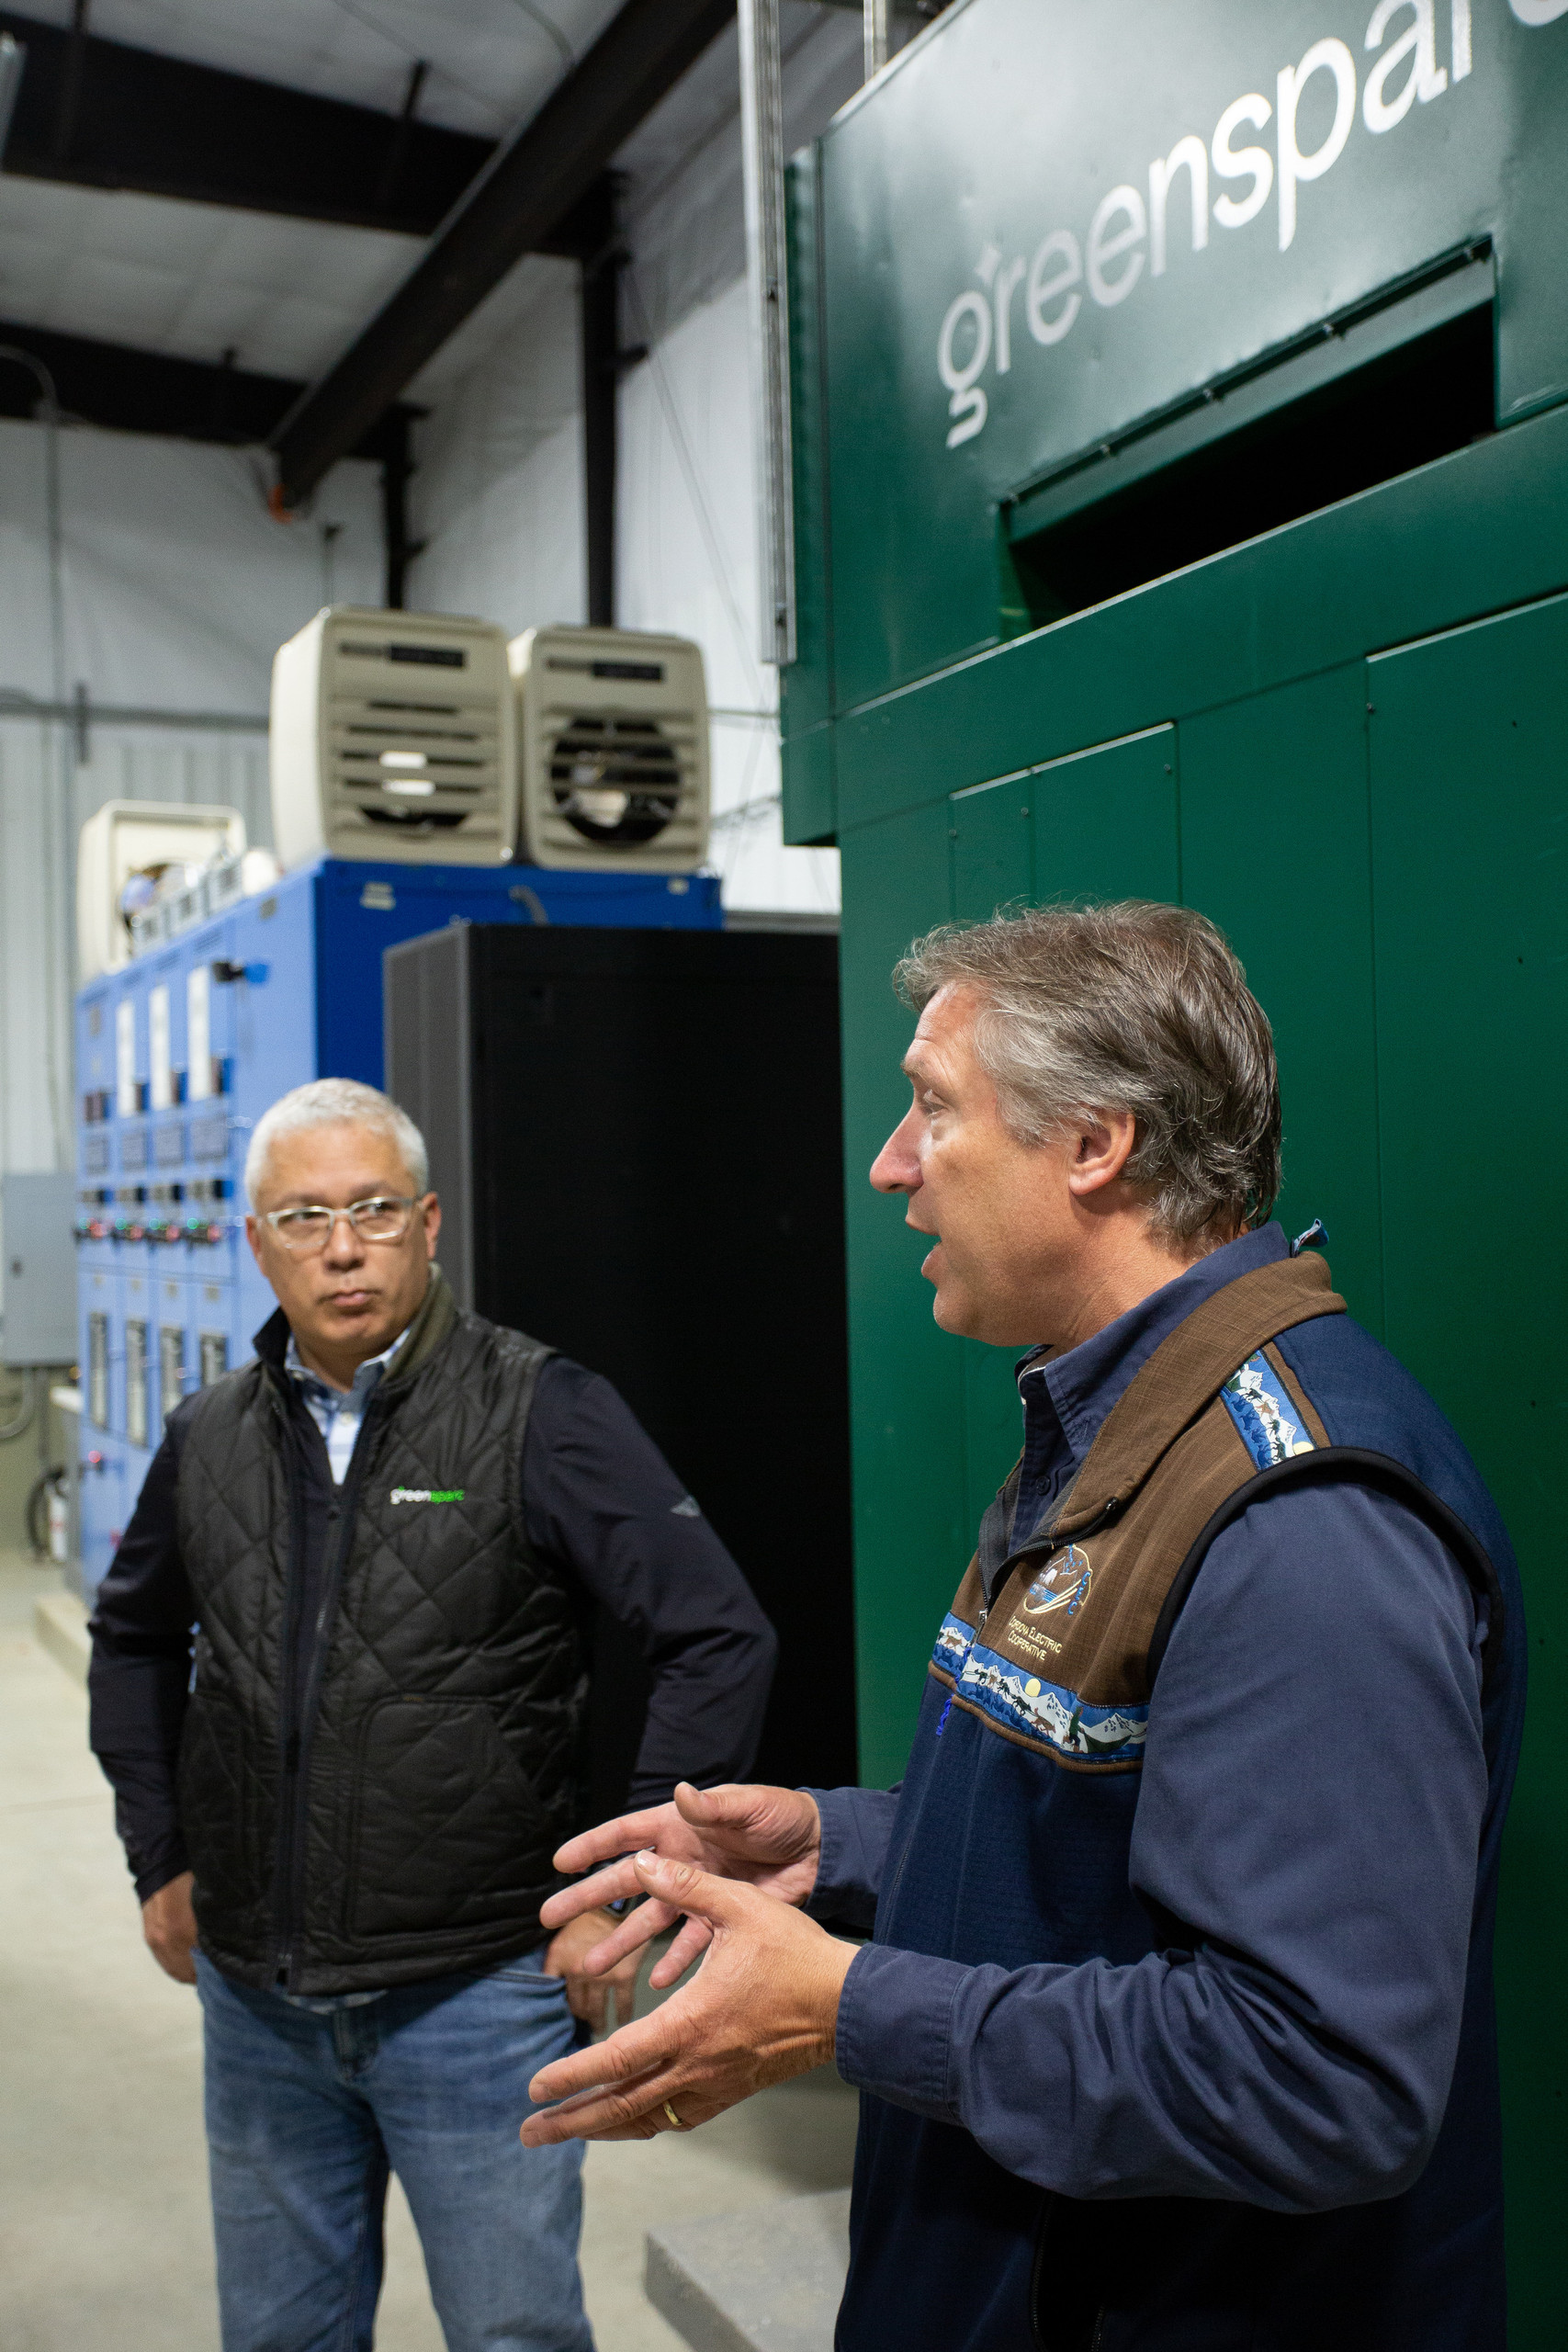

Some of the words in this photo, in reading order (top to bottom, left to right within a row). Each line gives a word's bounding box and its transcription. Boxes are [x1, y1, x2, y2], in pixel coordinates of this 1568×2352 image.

[937, 0, 1568, 449] greenspa
[1008, 1629, 1047, 1661] COOPERATIVE
[1028, 1626, 1063, 1654] ELECTRIC
